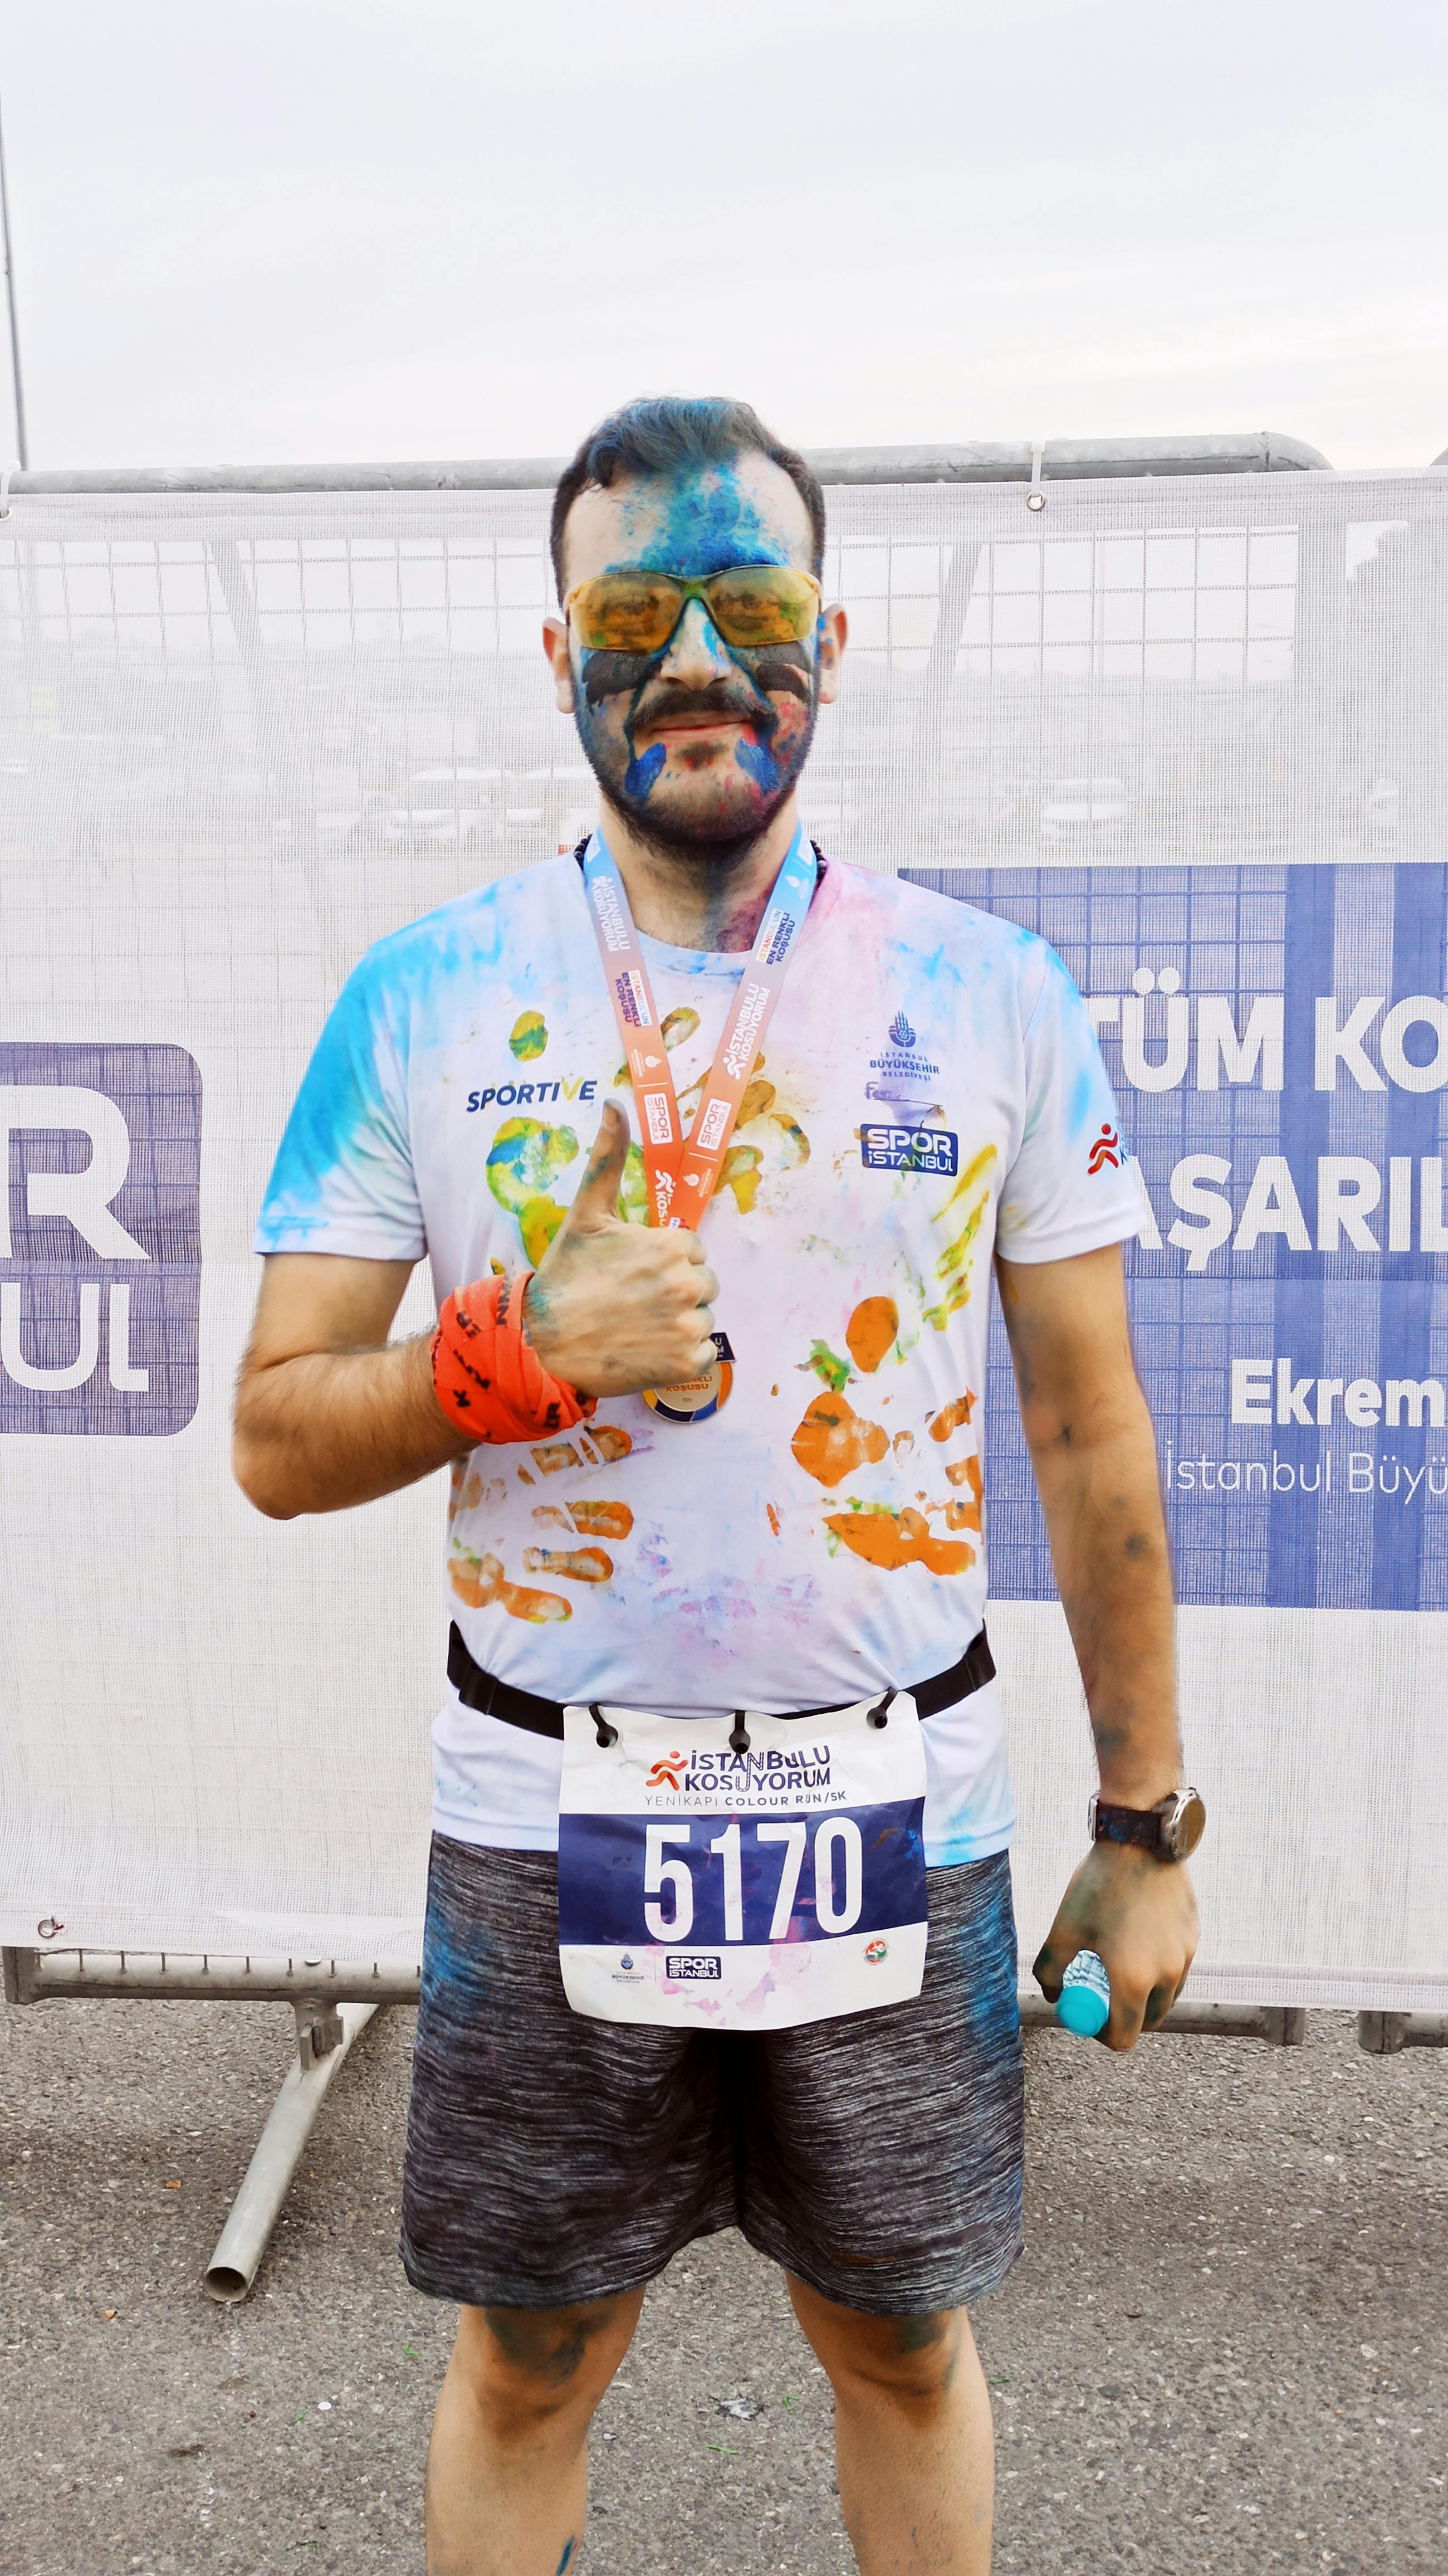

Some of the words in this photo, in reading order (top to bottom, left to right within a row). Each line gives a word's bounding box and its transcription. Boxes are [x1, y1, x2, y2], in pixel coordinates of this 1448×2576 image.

[766, 950, 776, 965] EN
[622, 972, 631, 987] EN
[1315, 995, 1448, 1093] KO
[466, 1076, 598, 1113] SPORTIVE
[654, 1097, 669, 1139] SPOR
[702, 1104, 720, 1144] SPOR
[867, 1128, 953, 1157] SPOR
[1231, 1358, 1445, 1427] Ekrem
[1167, 1440, 1330, 1492] İstanbul
[1349, 1452, 1448, 1505] Büyü
[645, 1794, 718, 1806] YENİKAPI
[725, 1796, 789, 1806] COLOUR
[644, 1817, 863, 1942] 5170
[669, 1957, 718, 1970] SPOR
